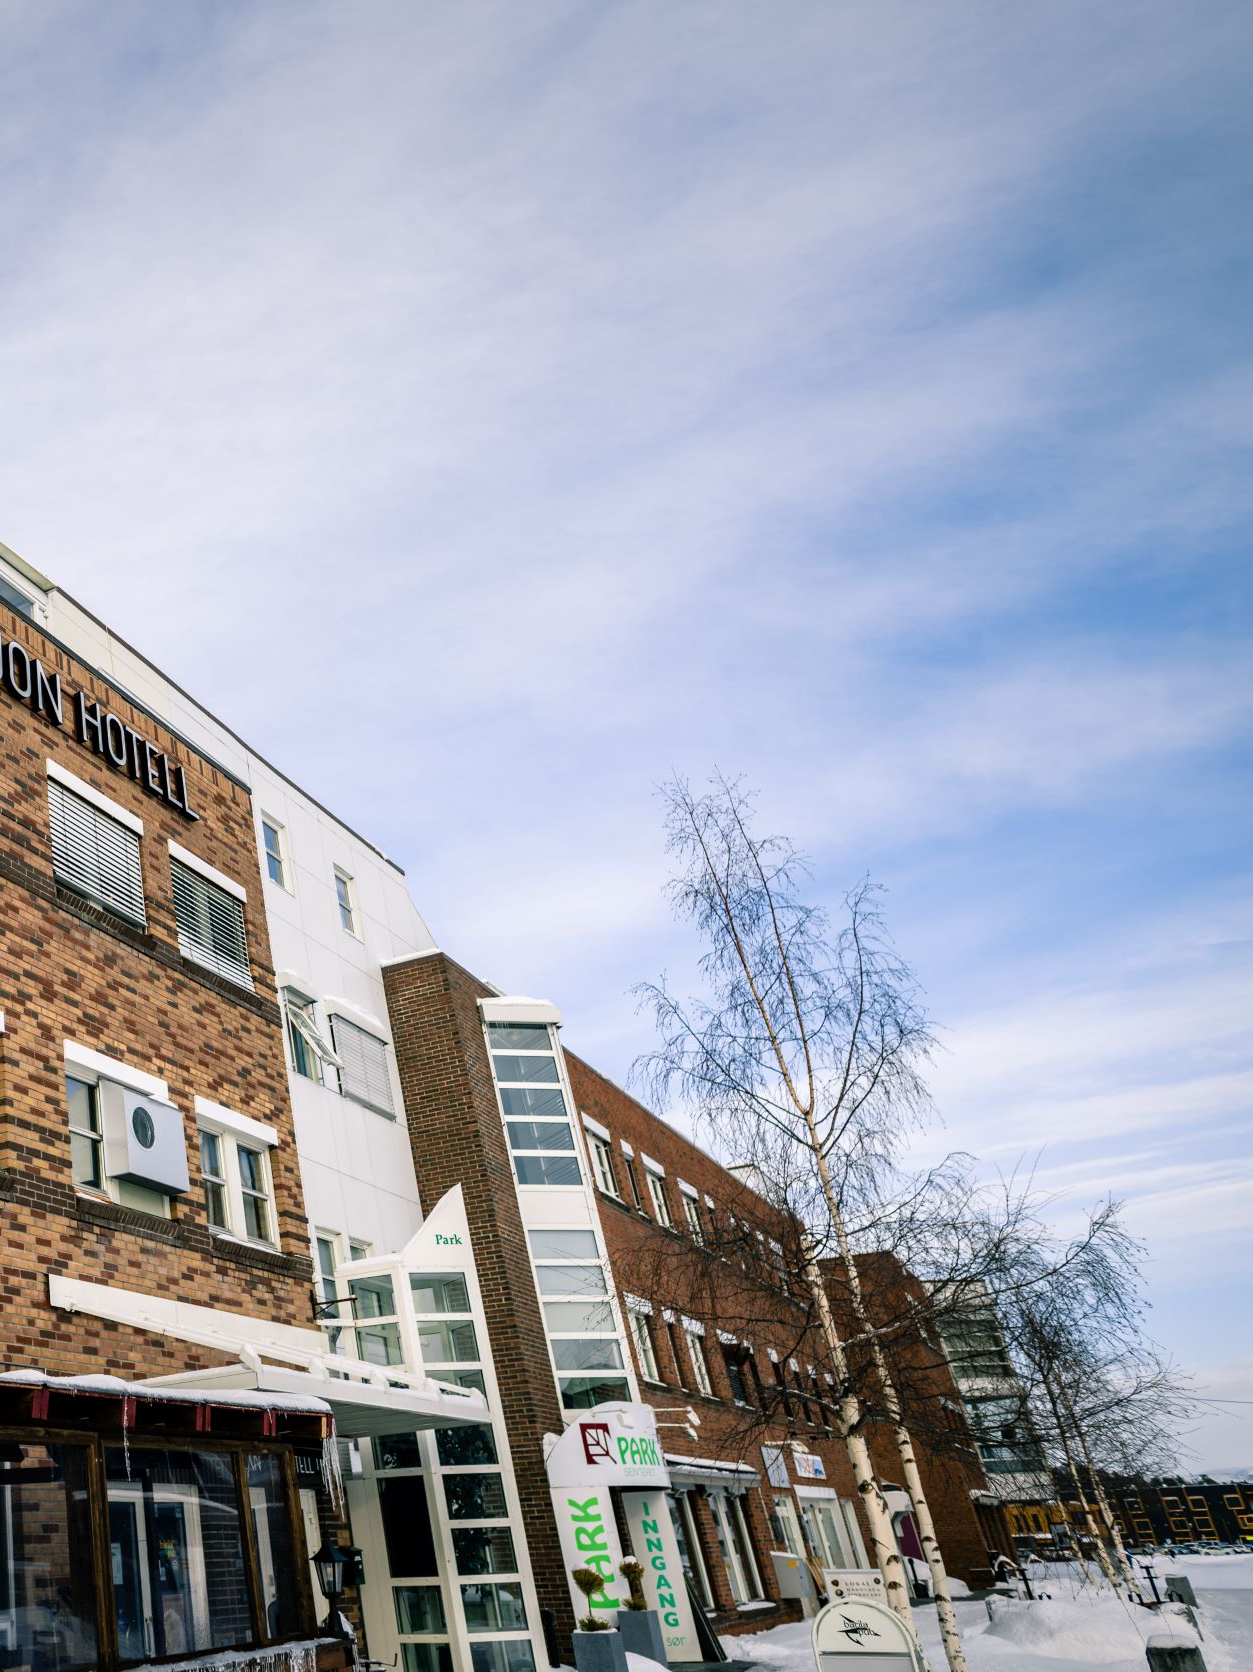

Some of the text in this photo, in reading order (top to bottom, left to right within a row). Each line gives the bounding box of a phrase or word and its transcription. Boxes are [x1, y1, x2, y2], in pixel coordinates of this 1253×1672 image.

[75, 691, 200, 821] HOTELL
[435, 1234, 463, 1245] Park
[617, 1437, 660, 1466] PARK
[295, 1456, 314, 1474] TELL
[567, 1497, 620, 1609] PARK
[641, 1502, 680, 1627] INNGANG
[666, 1637, 686, 1647] sør
[857, 1628, 876, 1637] pub
